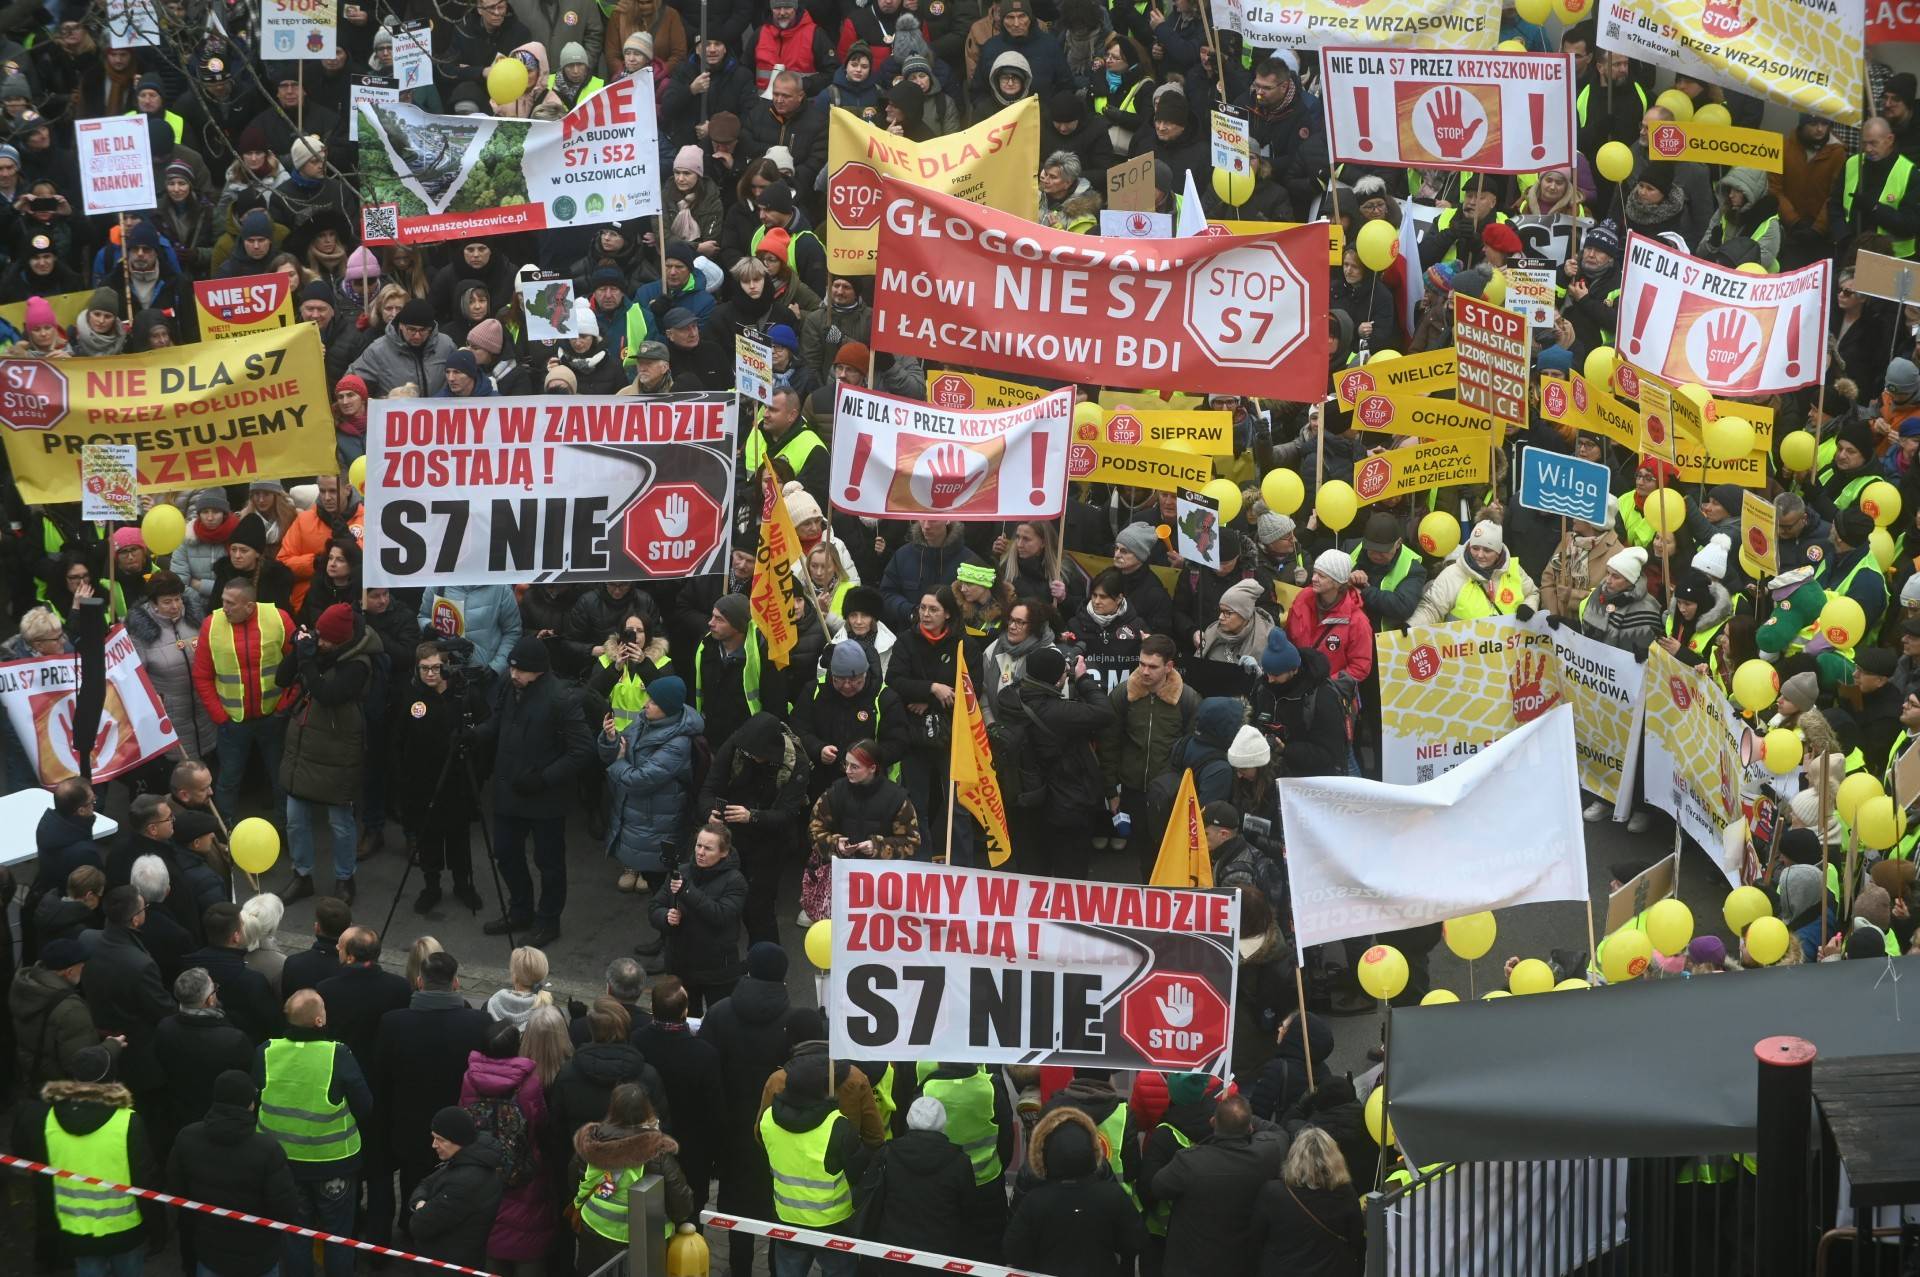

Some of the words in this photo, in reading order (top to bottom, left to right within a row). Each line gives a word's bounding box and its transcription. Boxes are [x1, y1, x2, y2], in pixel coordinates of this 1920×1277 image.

[267, 18, 280, 26] NIE
[1246, 7, 1274, 23] dla
[1280, 9, 1304, 25] S7
[1307, 14, 1358, 29] przez
[1365, 14, 1487, 35] WRZĄSOWICE!
[1610, 3, 1635, 25] NIE!
[1638, 16, 1658, 34] dla
[1661, 24, 1679, 41] S7
[1680, 34, 1721, 56] przez
[1703, 10, 1741, 33] STOP
[1627, 32, 1680, 58] s7krakow.pl
[1331, 57, 1354, 75] NIE
[1359, 58, 1385, 76] DLA
[1389, 59, 1405, 76] S7
[1411, 60, 1453, 77] PRZEZ
[1457, 60, 1563, 81] KRZYSZKOWICE
[561, 78, 637, 142] NIE
[586, 126, 636, 143] BUDOWY
[1216, 130, 1242, 145] STOP
[1437, 126, 1465, 141] STOP!
[1659, 139, 1680, 148] STOP
[1662, 128, 1675, 139] S7
[93, 137, 111, 156] NIE
[114, 135, 135, 151] DLA
[564, 147, 590, 168] S7
[602, 143, 636, 165] S52
[866, 135, 913, 173] NIE
[918, 143, 982, 179] DLA
[985, 121, 1019, 155] S7
[1689, 138, 1780, 159] GŁOGOCZÓW
[92, 171, 144, 193] KRAKÓW!
[551, 176, 562, 185] w
[564, 164, 646, 184] OLSZOWICACH
[1110, 160, 1153, 193] STOP
[403, 211, 529, 236] www.naszeolszowice.pl
[849, 207, 865, 218] S7
[833, 248, 865, 261] STOP
[1208, 265, 1287, 303] STOP
[1631, 244, 1655, 269] NIE
[1655, 255, 1679, 281] DLA
[1682, 265, 1700, 285] S7
[1701, 272, 1748, 300] PRZEZ
[1750, 270, 1820, 302] KRZYSZKOWICE
[249, 283, 278, 313] S7
[881, 266, 975, 308] MÓWI
[993, 263, 1090, 317] NIE
[1106, 274, 1174, 324] S7
[1514, 285, 1546, 296] STOP
[234, 305, 251, 315] dla
[1464, 304, 1518, 337] STOP
[1217, 306, 1275, 346] S7
[877, 308, 886, 334] I
[896, 312, 1104, 366] ŁĄCZNIKOWI
[1114, 334, 1182, 373] BDI
[1708, 349, 1738, 364] STOP!
[7, 365, 38, 389] S7
[86, 368, 148, 399] NIE
[160, 361, 235, 395] DLA
[244, 348, 288, 382] S7
[1349, 374, 1362, 387] S7
[1623, 367, 1632, 380] S7
[944, 378, 960, 392] S7
[1550, 385, 1560, 398] S7
[3, 391, 50, 410] STOP
[87, 404, 168, 426] PRZEZ
[175, 378, 301, 420] POŁUDNIE
[940, 392, 966, 404] STOP
[986, 396, 1005, 409] MA
[1369, 399, 1383, 410] S7
[385, 407, 490, 448] DOMY
[497, 406, 538, 446] W
[543, 401, 726, 444] ZAWADZIE
[842, 395, 863, 421] NIE
[867, 401, 890, 425] DLA
[894, 406, 910, 427] S7
[914, 413, 956, 436] PRZEZ
[959, 398, 1068, 437] KRZYSZKOWICE
[1116, 418, 1130, 431] S7
[1364, 410, 1386, 418] STOP
[1411, 410, 1492, 431] OCHOJNO
[1596, 402, 1634, 437] WŁOSAŃ
[1113, 430, 1135, 440] STOP
[1150, 427, 1223, 441] SIEPRAW
[1073, 447, 1086, 458] S7
[1415, 444, 1459, 460] DROGA
[381, 447, 536, 492] ZOSTAJĄ
[1101, 456, 1207, 483] PODSTOLICE
[1366, 462, 1379, 478] S7
[1403, 463, 1420, 476] MA
[1423, 454, 1472, 472] ŁĄCZYĆ
[933, 481, 964, 495] STOP!
[1362, 475, 1384, 490] STOP
[1397, 476, 1416, 489] NIE
[1419, 468, 1477, 485] DZIELIĆ!!!
[1538, 460, 1599, 498] Wilga
[379, 498, 471, 577] S7
[487, 495, 611, 573] NIE
[648, 539, 697, 561] STOP
[442, 617, 456, 635] S7
[1411, 649, 1428, 663] NIE
[1442, 642, 1474, 659] NIE!
[1478, 640, 1503, 655] dla
[1506, 632, 1522, 650] S7
[1524, 634, 1554, 648] prz
[1419, 664, 1432, 677] S7
[1555, 644, 1617, 683] POŁUDNIE
[18, 668, 36, 690] S7
[1565, 666, 1630, 704] KRAKOWA
[1513, 694, 1545, 715] STOP
[1690, 686, 1706, 711] NIE!
[1706, 702, 1720, 722] dla
[1415, 743, 1448, 761] NIE!
[1452, 740, 1479, 756] dla
[1575, 741, 1624, 773] SOWICE
[1672, 768, 1688, 795] NIE!
[847, 871, 969, 916] DOMY
[976, 876, 1020, 917] W
[1028, 879, 1231, 935] ZAWADZIE
[846, 912, 1018, 964] ZOSTAJĄ
[845, 963, 947, 1048] S7
[968, 965, 1106, 1053] NIE
[1148, 1027, 1204, 1052] STOP
